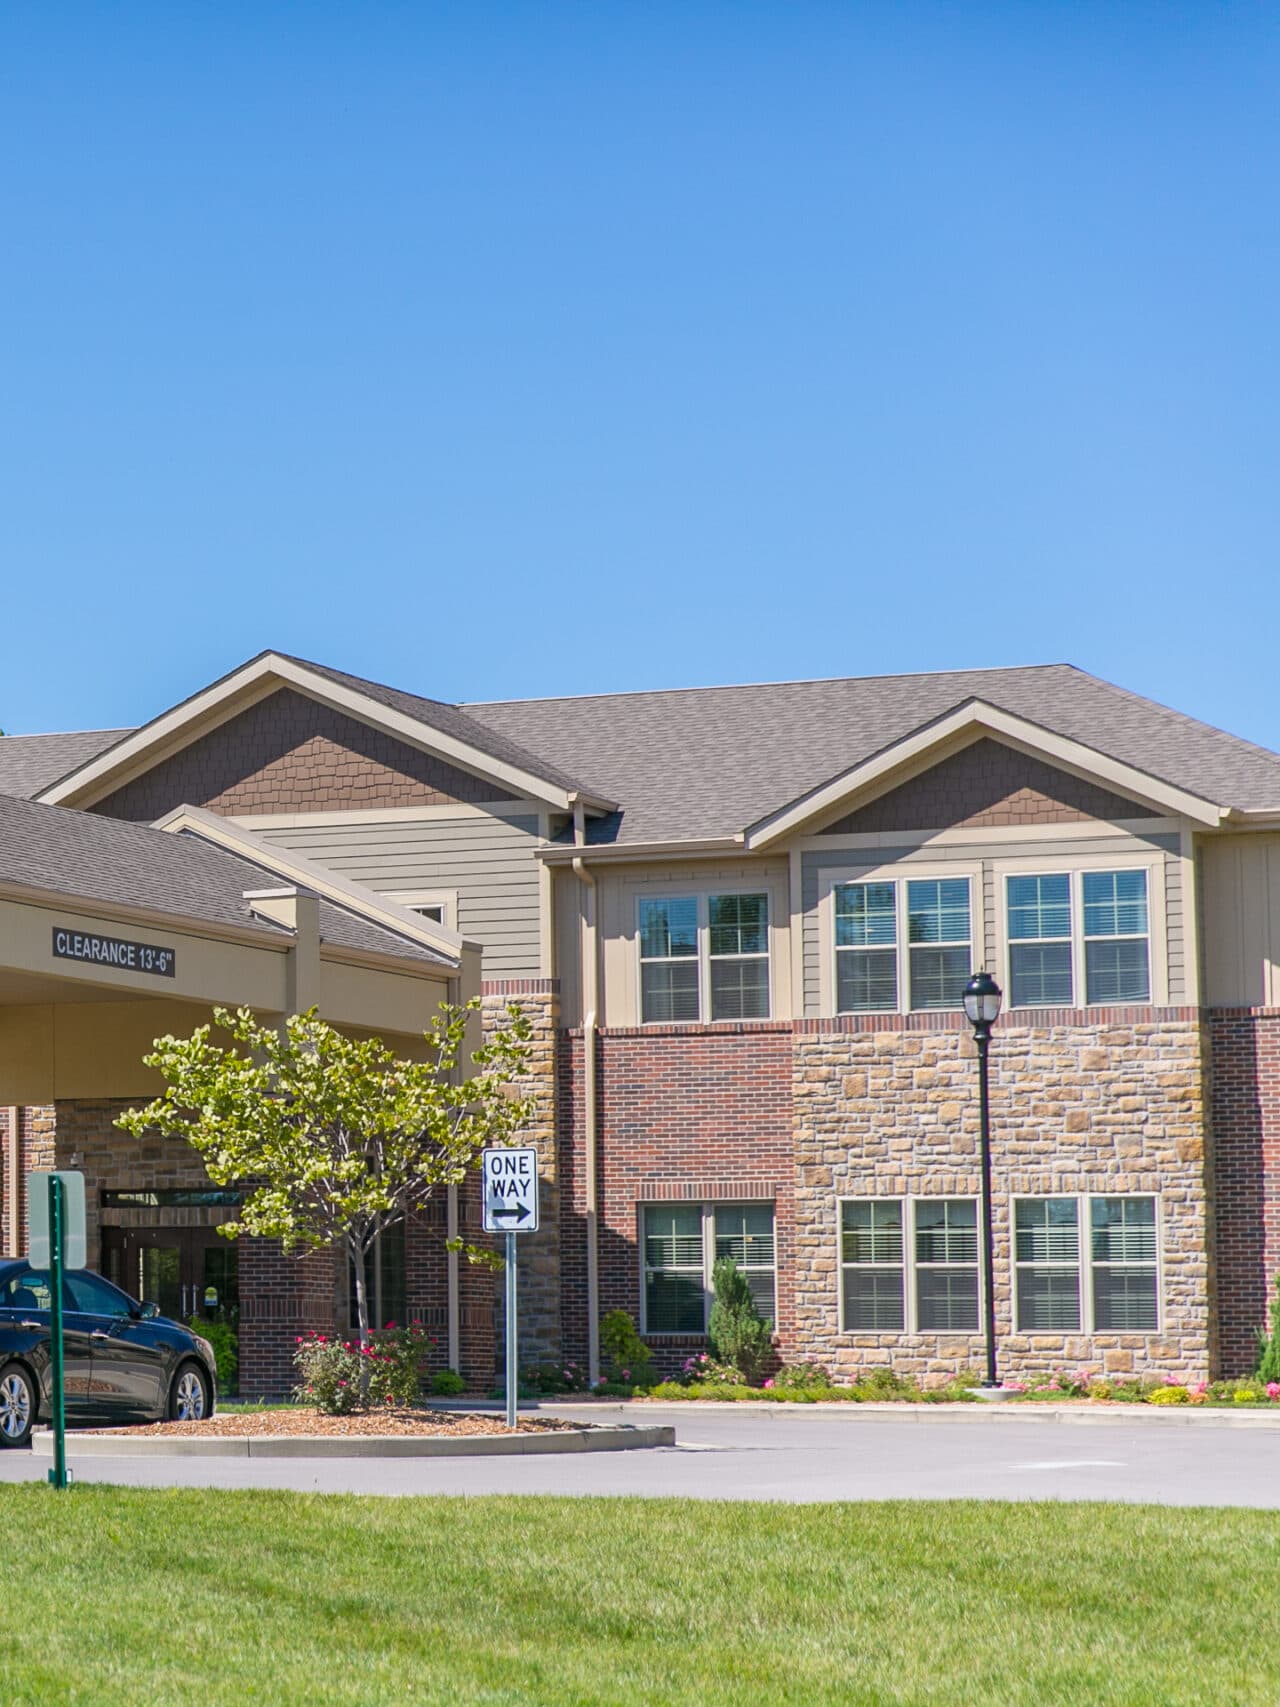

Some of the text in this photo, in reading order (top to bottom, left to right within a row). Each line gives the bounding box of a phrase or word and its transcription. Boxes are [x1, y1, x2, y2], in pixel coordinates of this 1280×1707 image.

[56, 932, 136, 967] CLEARANCE
[491, 1156, 529, 1175] ONE
[492, 1179, 531, 1198] WAY
